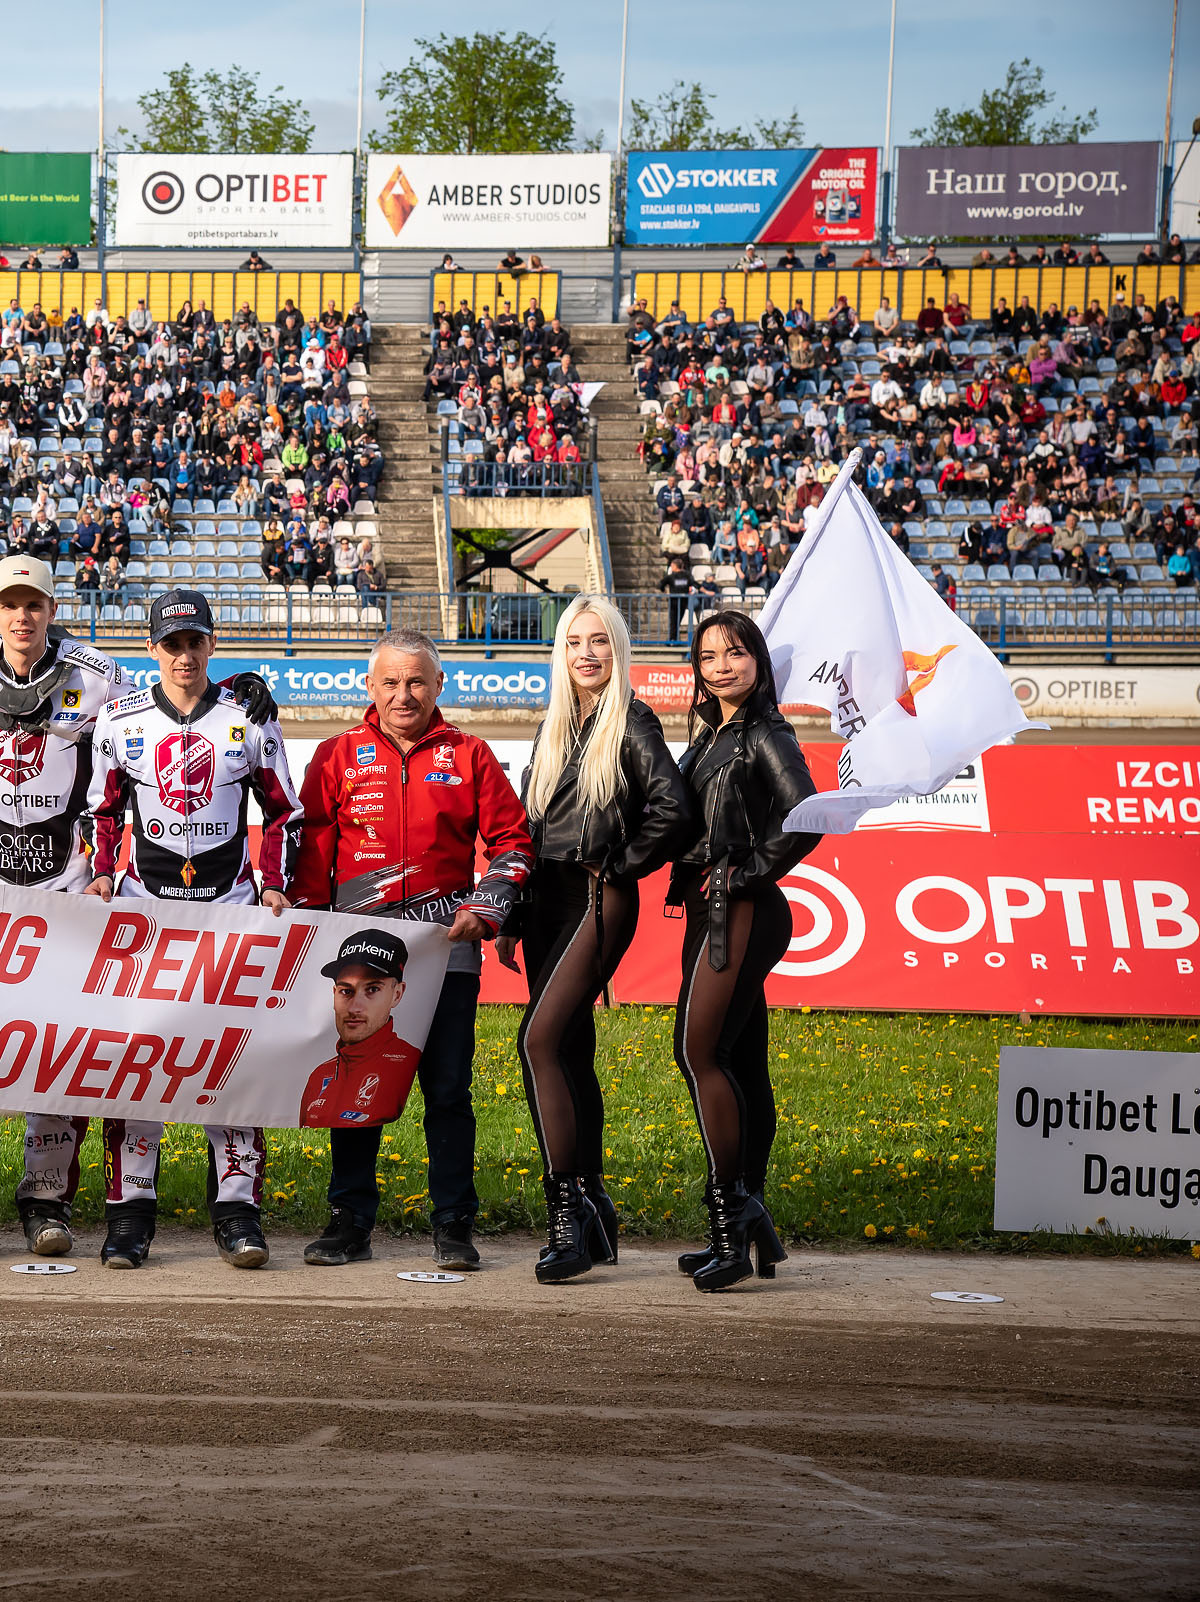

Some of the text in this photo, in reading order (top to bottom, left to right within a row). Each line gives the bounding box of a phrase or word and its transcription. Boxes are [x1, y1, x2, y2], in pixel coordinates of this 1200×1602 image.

[848, 158, 866, 169] THE
[675, 169, 778, 188] STOKKER
[819, 169, 865, 179] ORIGINAL
[196, 174, 327, 203] OPTIBET
[812, 179, 865, 190] MOTOR OIL
[926, 169, 1128, 199] Наш город.
[9, 194, 28, 203] Beer
[30, 194, 38, 203] in
[39, 194, 53, 203] the
[55, 194, 80, 203] World
[428, 183, 601, 207] AMBER STUDIOS
[197, 206, 266, 215] SPORTA
[640, 204, 675, 215] STACIJAS
[676, 204, 692, 214] IELA
[714, 203, 760, 214] DAUGAVPILS
[966, 202, 1085, 220] www.gorod.lv
[442, 211, 587, 223] WWW.AMBER-STUDIOS.COM
[640, 219, 700, 230] www.stokker.lv
[187, 228, 278, 240] optibetsportabars.lv
[1115, 275, 1127, 291] K
[122, 666, 160, 687] tro
[453, 670, 546, 693] trodo
[289, 693, 372, 702] CAR PARTS ONLIN
[639, 686, 694, 697] REMONTA
[1048, 681, 1137, 699] OPTIBET
[459, 695, 478, 703] CAR
[479, 695, 508, 703] PARTS
[358, 765, 387, 775] OPTIBET
[1116, 761, 1200, 788] IZCI
[1, 794, 60, 809] OPTIBET
[351, 793, 383, 802] TRODO
[916, 793, 978, 804] GERMANY
[1087, 797, 1200, 823] REMO
[169, 822, 229, 836] OPTIBET
[0, 856, 47, 873] BEAR
[159, 886, 216, 899] AMBER STUDIOS
[896, 876, 1200, 949] OPTIB
[341, 941, 394, 961] dankemi
[81, 911, 318, 1010] RENE!
[903, 950, 1132, 974] SPORTA
[1015, 1087, 1158, 1138] Optibet
[1083, 1154, 1200, 1209] Dauga
